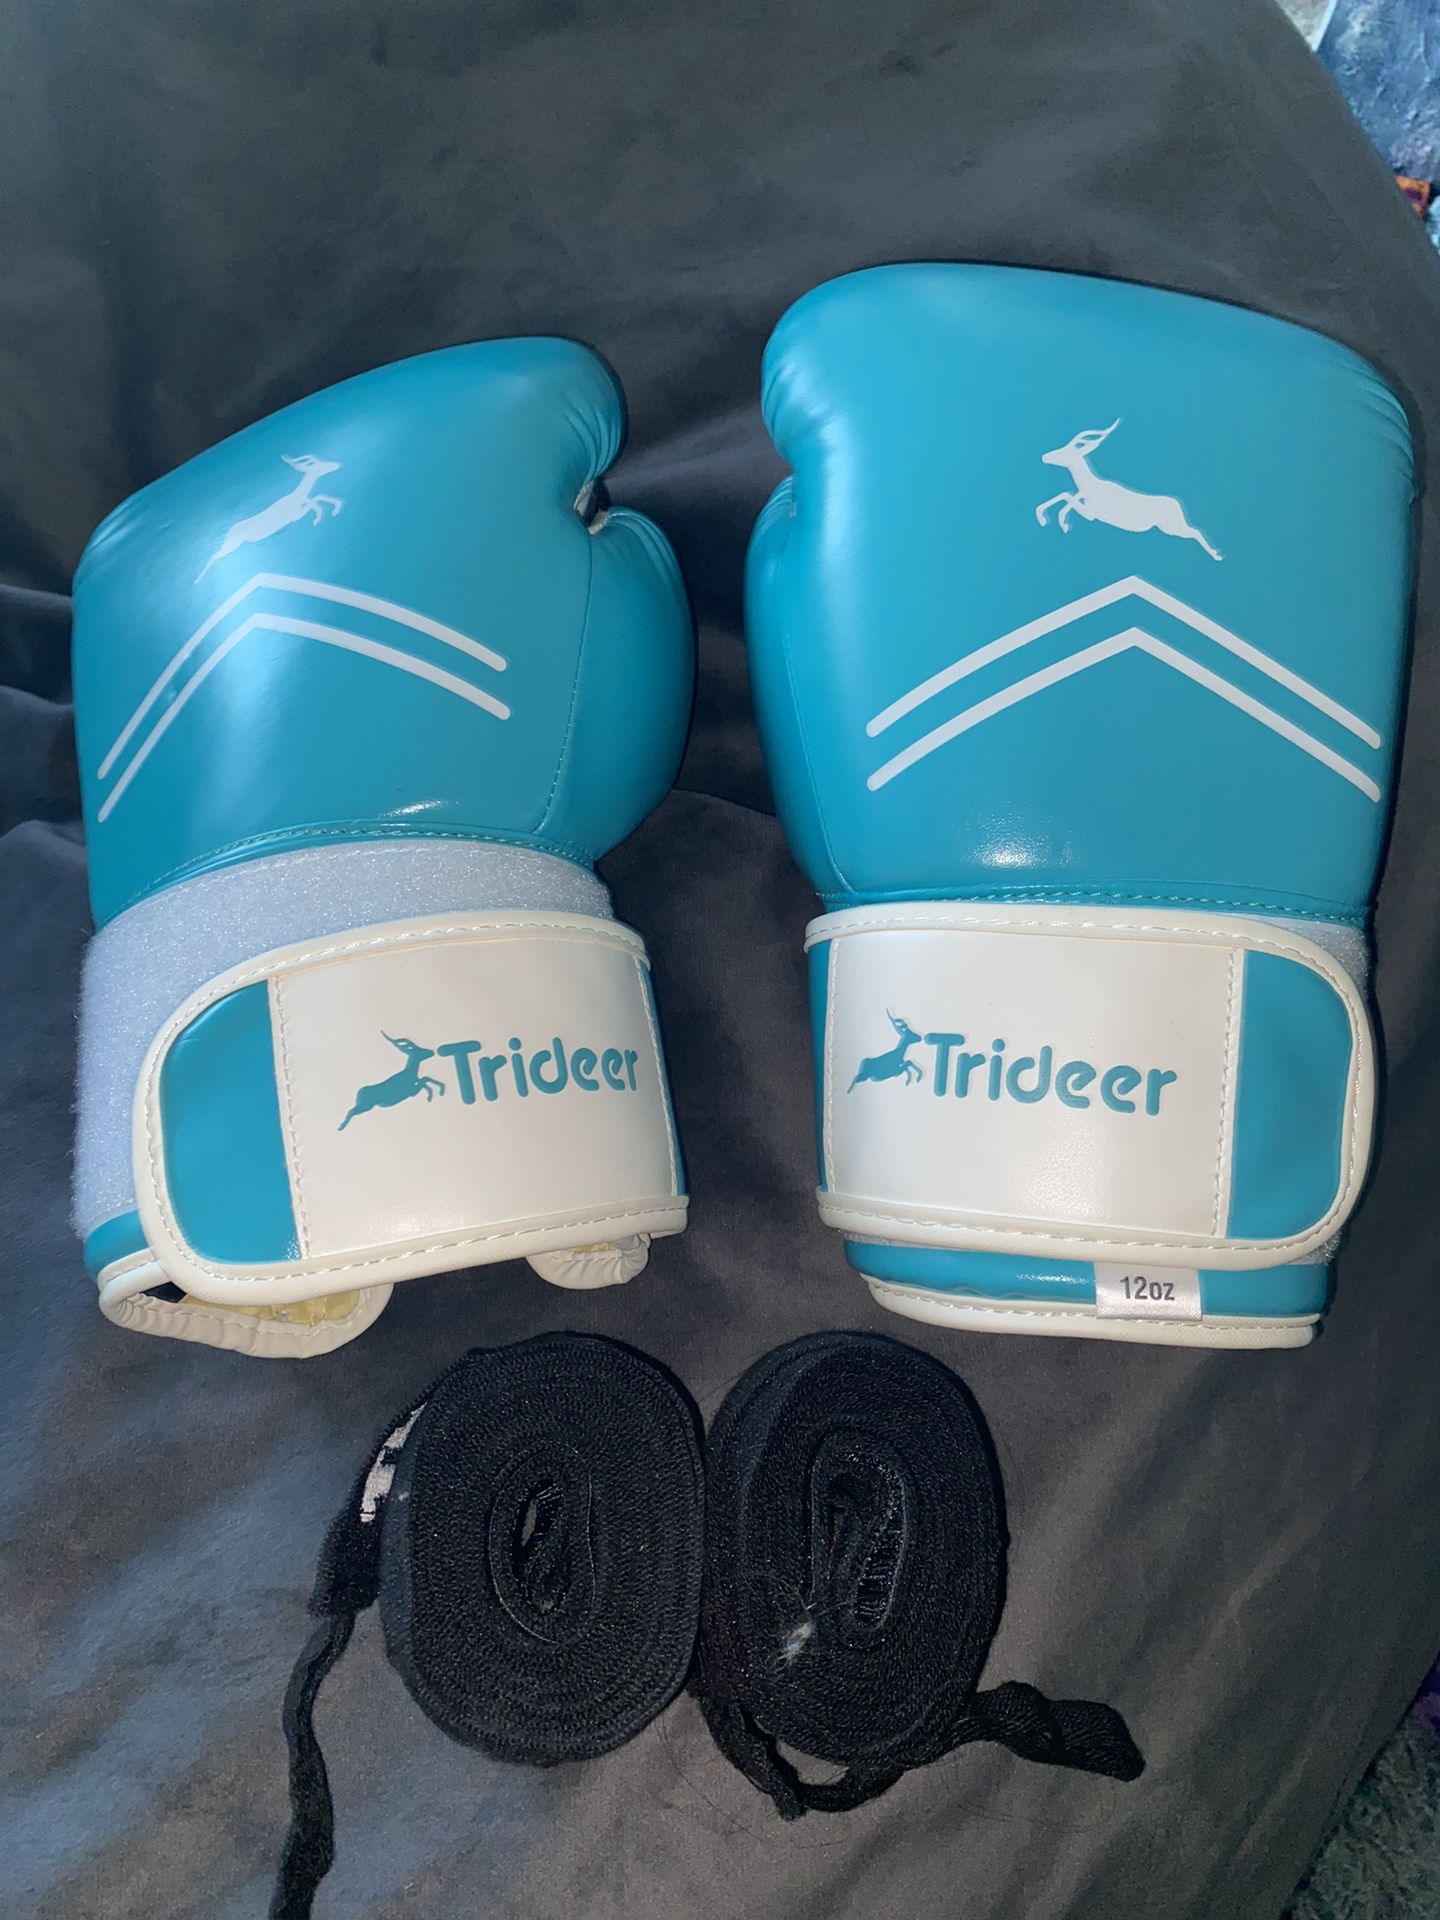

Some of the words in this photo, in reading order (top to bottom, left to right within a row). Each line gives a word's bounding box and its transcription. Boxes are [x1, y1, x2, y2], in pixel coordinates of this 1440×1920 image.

[437, 1037, 638, 1105] Trideer
[924, 1033, 1177, 1116] Trideer
[1120, 1276, 1175, 1301] 12oz
